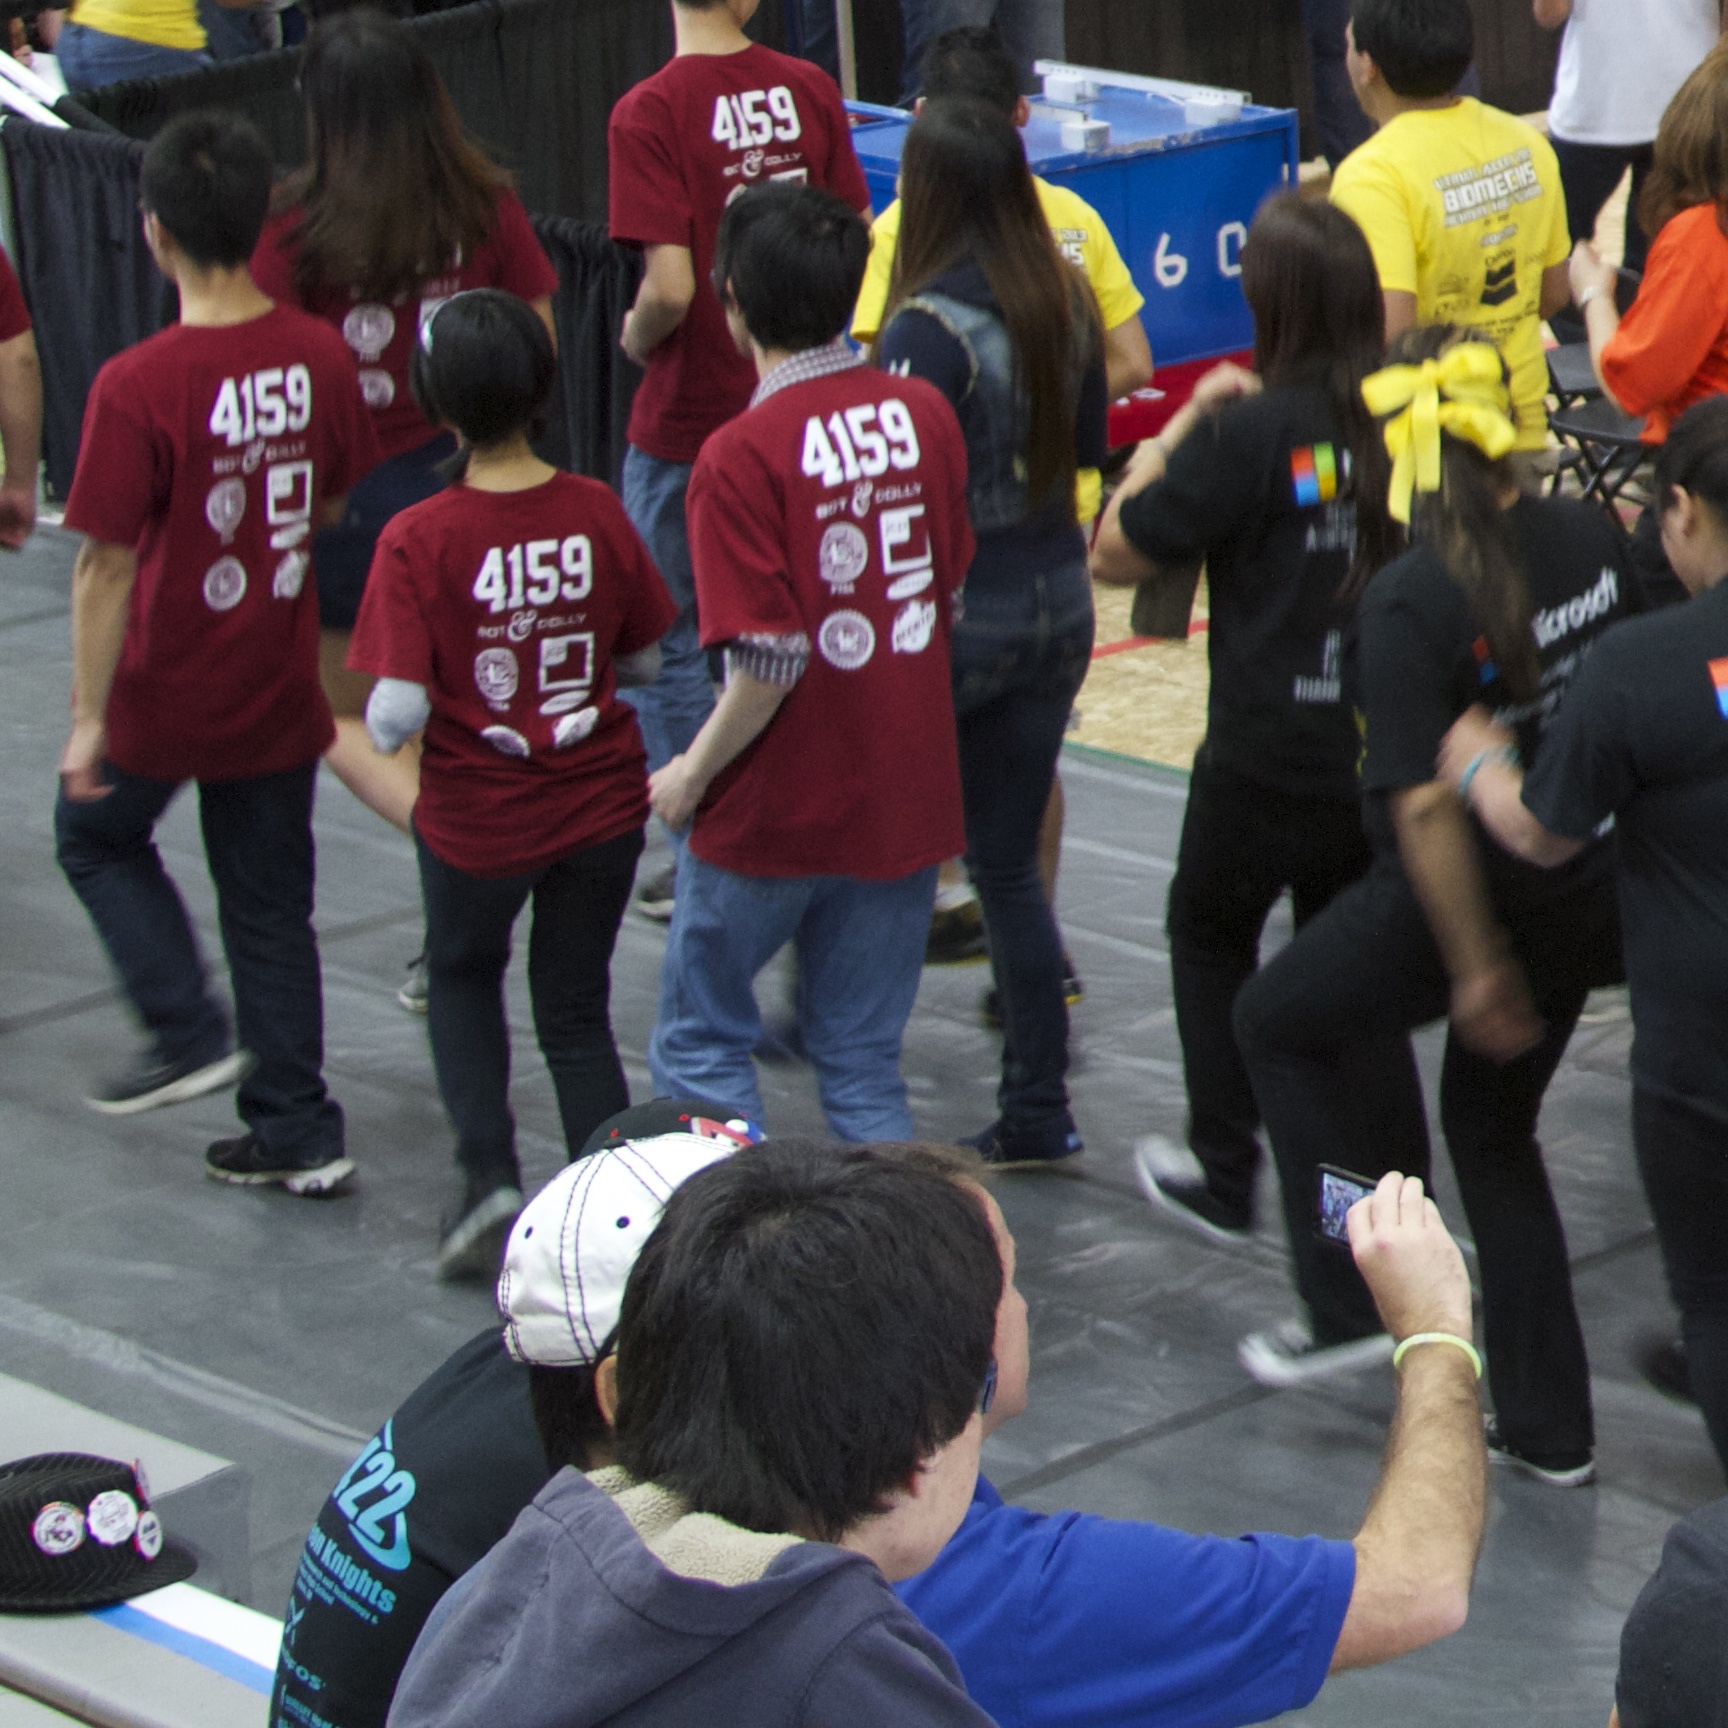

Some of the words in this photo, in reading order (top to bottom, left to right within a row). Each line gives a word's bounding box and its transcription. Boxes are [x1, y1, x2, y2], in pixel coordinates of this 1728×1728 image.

[711, 84, 802, 152] 4159
[1443, 160, 1538, 214] BIOMECHS
[208, 362, 312, 448] 4159
[800, 397, 921, 489] 4159
[851, 478, 873, 519] &
[472, 533, 594, 615] 4159
[1530, 564, 1619, 650] icrosoft
[507, 609, 538, 642] &
[320, 1542, 397, 1615] Knights
